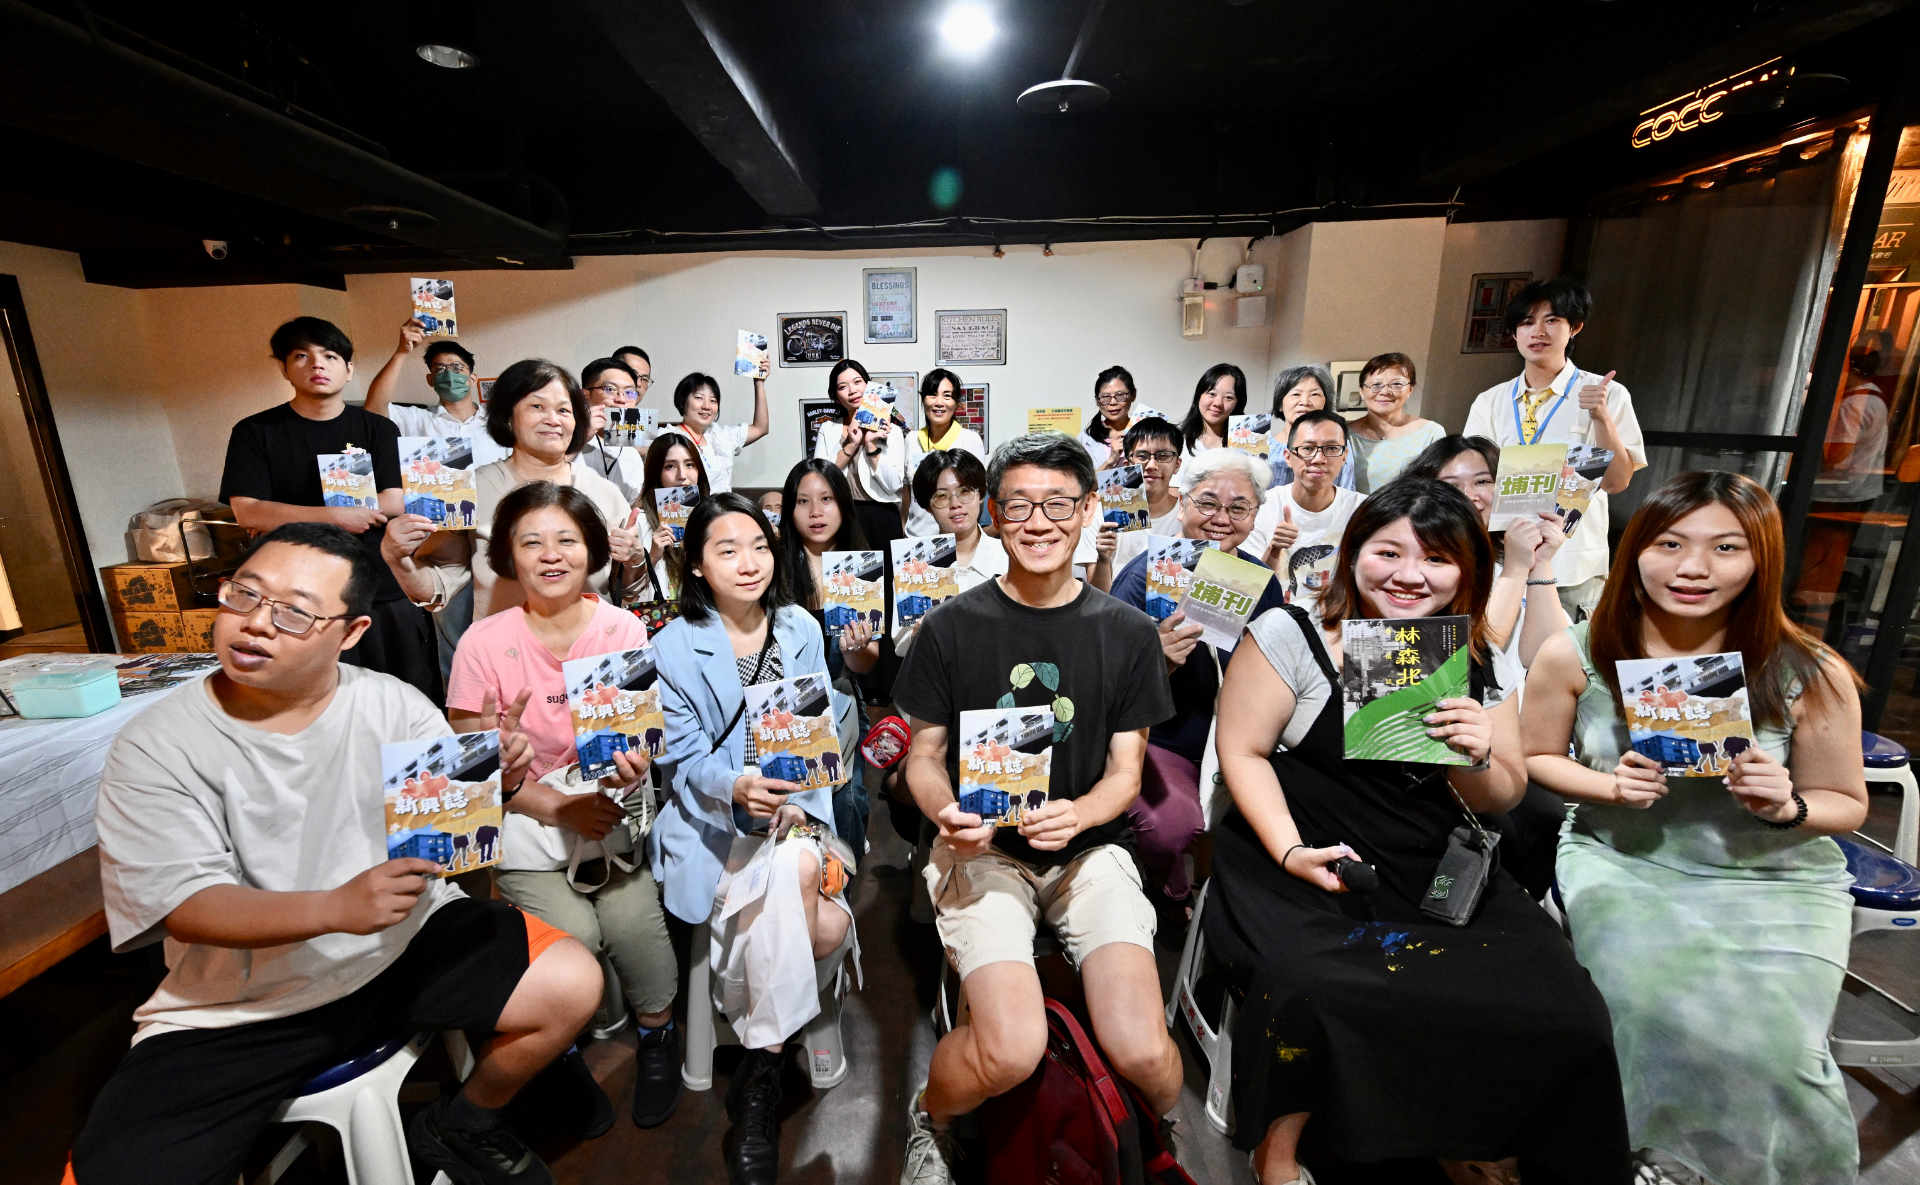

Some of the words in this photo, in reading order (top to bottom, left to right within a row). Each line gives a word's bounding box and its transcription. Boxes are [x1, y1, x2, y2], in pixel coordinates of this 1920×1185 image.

[872, 281, 909, 289] BLESSINGS
[784, 318, 811, 336] LEGENDS
[811, 318, 831, 328] NEVER
[830, 323, 842, 333] DIE
[806, 408, 840, 417] HARLEY-DAVID
[1499, 473, 1558, 497] 埔刊
[1188, 578, 1256, 616] 埔刊
[1395, 626, 1421, 686] 林森北
[578, 696, 637, 720] 新興誌
[1634, 702, 1713, 721] 新興誌
[759, 722, 811, 743] 新興誌
[967, 756, 1025, 775] 新興誌
[394, 789, 470, 816] 新興誌
